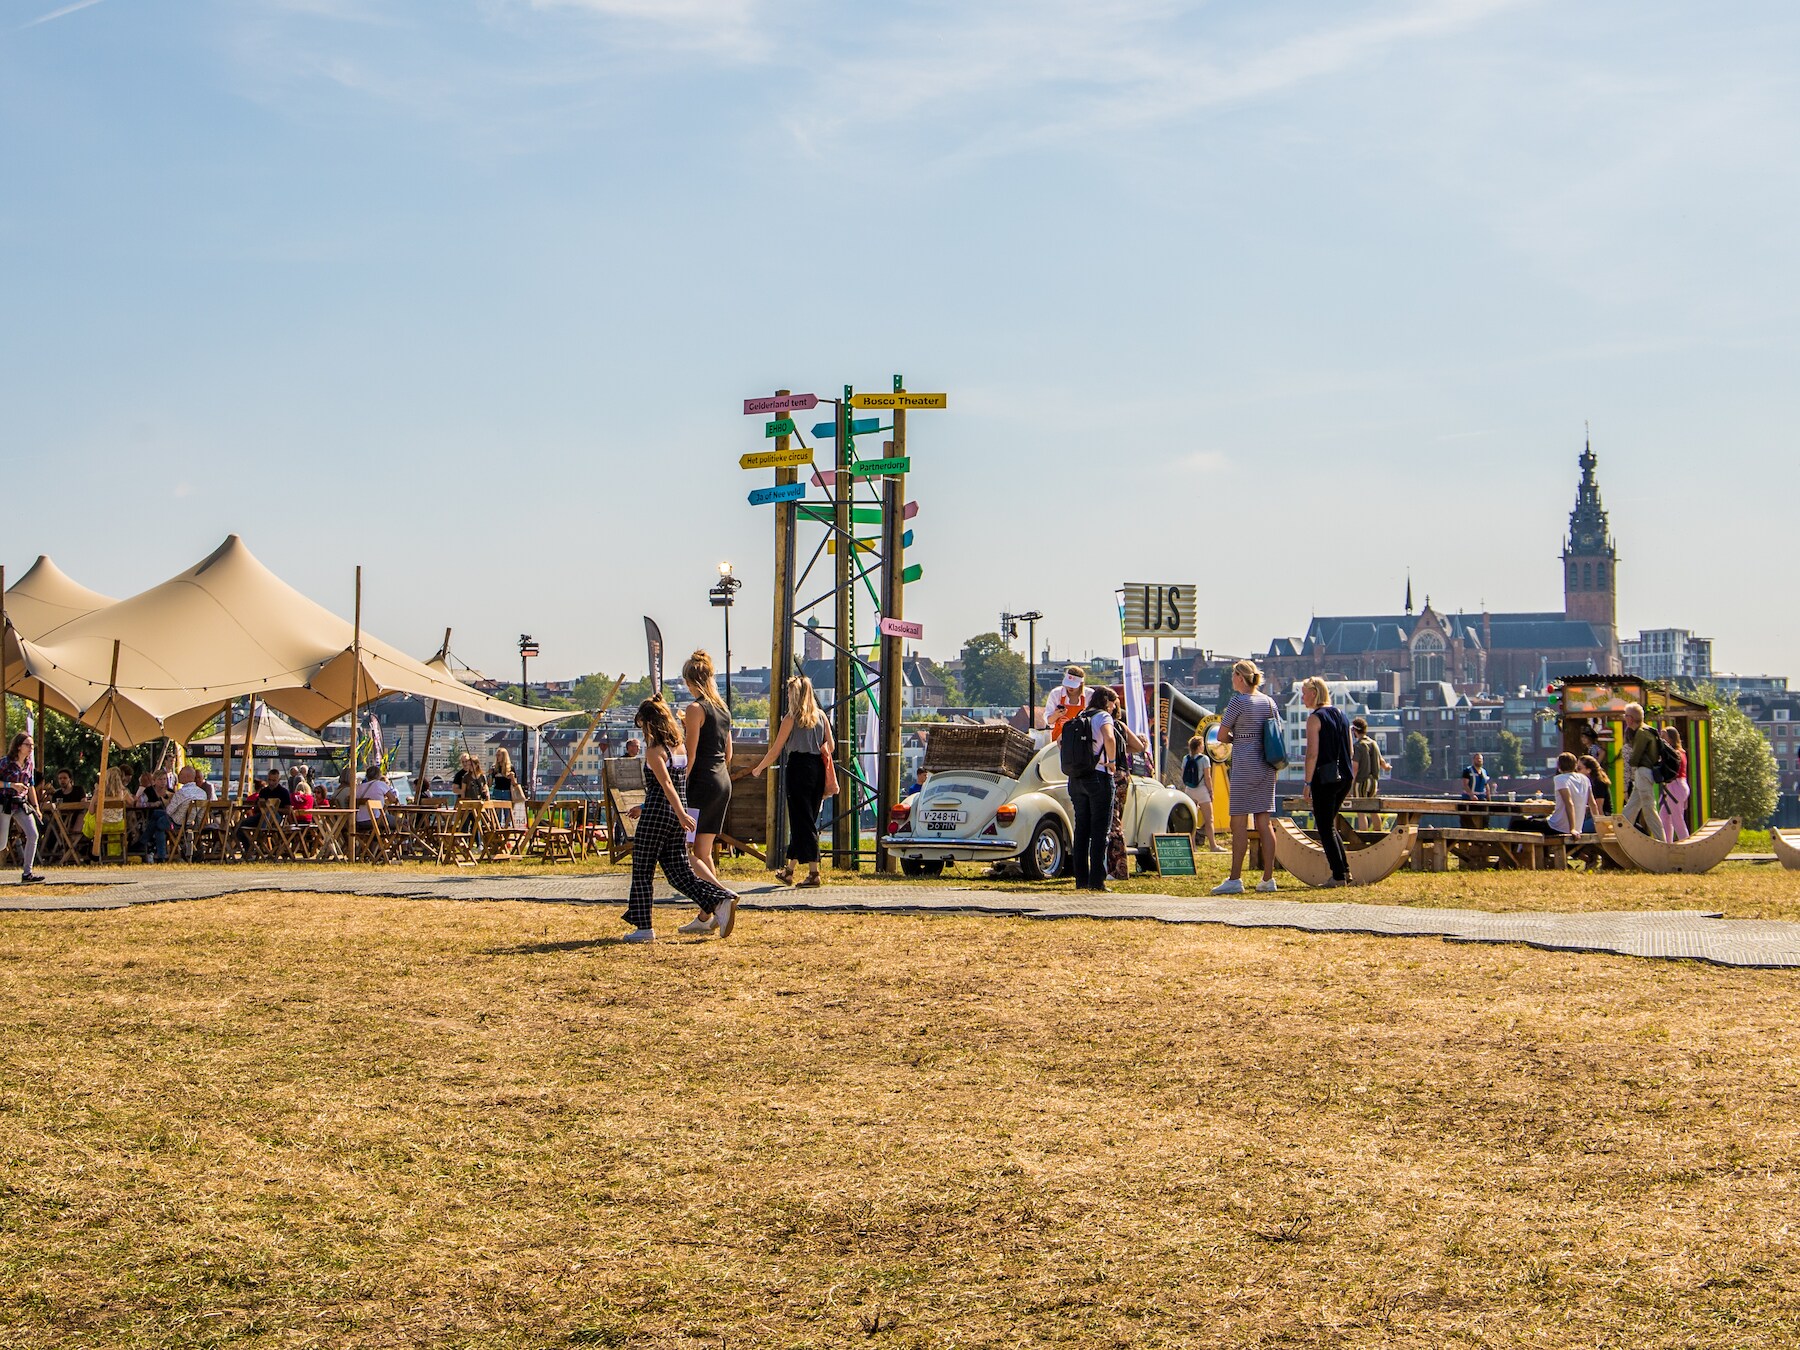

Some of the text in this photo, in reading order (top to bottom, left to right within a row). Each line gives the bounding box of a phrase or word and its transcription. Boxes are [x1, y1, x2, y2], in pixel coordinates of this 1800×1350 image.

[748, 398, 807, 411] Gelderland tent
[863, 397, 939, 405] Bosco Theater
[769, 423, 787, 434] EHBO
[747, 452, 808, 465] Het politieke circus
[859, 460, 905, 472] Partnerdorp
[756, 493, 763, 502] Ja
[765, 492, 772, 500] of
[787, 487, 801, 497] veld
[1144, 585, 1180, 631] IJS
[888, 622, 919, 635] Klaslokaal
